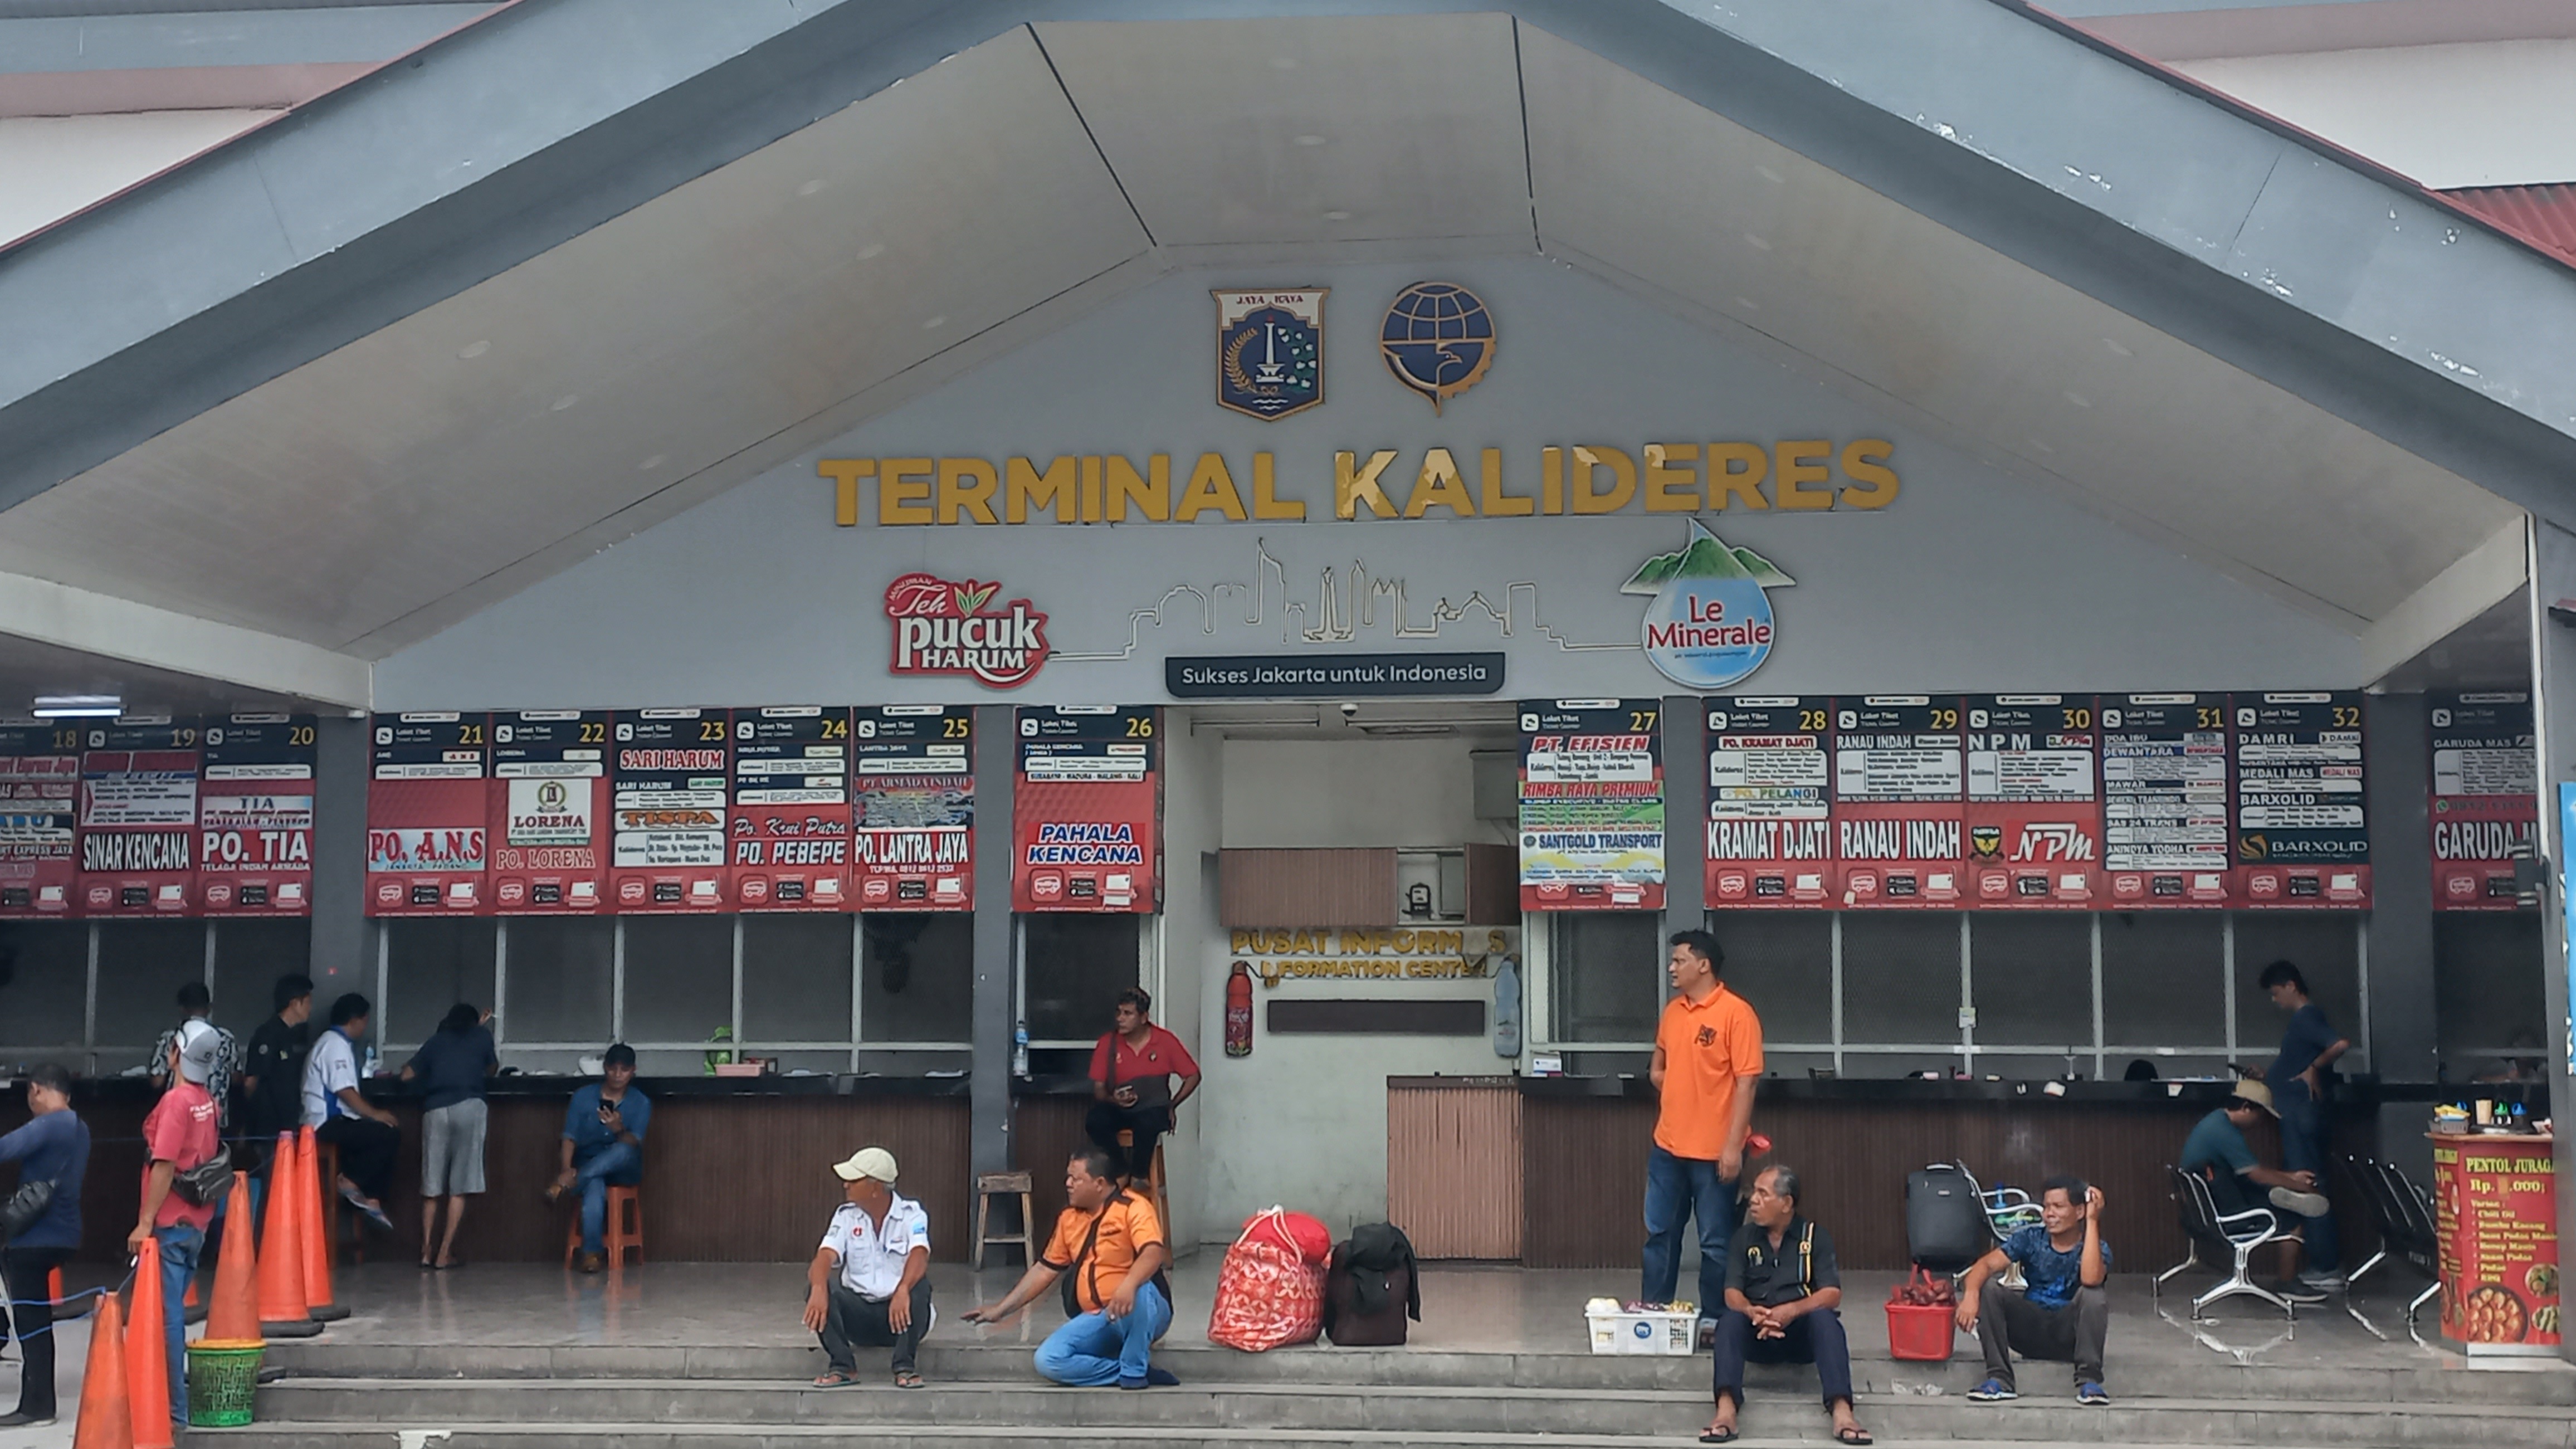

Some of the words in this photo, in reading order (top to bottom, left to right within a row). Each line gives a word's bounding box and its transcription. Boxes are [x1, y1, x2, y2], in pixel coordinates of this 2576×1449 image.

[817, 452, 1306, 526] TERMINAL
[1334, 439, 1900, 520] KALIDERES
[889, 584, 948, 616] Teh
[1689, 596, 1723, 623] Le
[897, 606, 1041, 669] pucuk
[1647, 618, 1771, 649] Minerale
[921, 648, 1026, 669] HARUM
[1182, 668, 1248, 684] Sukses
[1252, 666, 1326, 684] Jakarta
[1329, 666, 1385, 682] untuk
[1389, 663, 1486, 681] Indonesia
[1629, 711, 1657, 732] 27
[1799, 710, 1827, 730] 28
[1929, 709, 1958, 730] 29
[2062, 709, 2091, 729] 30
[2196, 708, 2224, 729] 31
[2332, 707, 2360, 727] 32
[171, 728, 196, 747] 19
[289, 726, 315, 745] 20
[459, 726, 484, 744] 21
[579, 724, 606, 742] 22
[699, 721, 725, 741] 23
[821, 720, 848, 739] 24
[943, 718, 969, 738] 25
[1126, 718, 1153, 737] 26
[54, 730, 77, 748] 18
[1531, 736, 1563, 753] PT.
[1568, 735, 1651, 753] EFISIEN
[1723, 739, 1739, 748] PO.
[1741, 739, 1783, 748] KRAMAT
[1785, 738, 1814, 748] DJATI
[1836, 735, 1874, 749] RANAU
[1877, 734, 1911, 749] INDAH
[2239, 734, 2294, 744] DAMRI
[2434, 739, 2483, 748] GARUDA
[620, 749, 661, 770] SARI
[662, 749, 725, 770] HARUM
[2103, 747, 2174, 757] DEWANTARA
[2240, 768, 2285, 779] MEDALI
[2287, 768, 2314, 778] MAS
[1523, 783, 1562, 797] RIMBA
[1602, 782, 1659, 797] PREMIUM
[1760, 788, 1817, 798] PELANGI
[240, 798, 275, 809] TIA
[2240, 794, 2315, 806] BARXOLID
[514, 816, 585, 828] LORENA
[734, 818, 756, 837] Po.
[1038, 823, 1133, 843] PAHALA
[1598, 834, 1662, 848] TRANSPORT
[1707, 821, 1778, 860] KRAMAT
[1783, 821, 1831, 860] DJATI
[1840, 821, 1901, 860] RANAU
[1906, 820, 1961, 860] INDAH
[2434, 822, 2515, 860] GARUDA
[84, 834, 123, 871] SINAR
[125, 832, 189, 870] KENCANA
[202, 832, 250, 862] PO.
[260, 832, 309, 861] TIA
[735, 842, 765, 865] PO.
[772, 841, 847, 865] PEBEPE
[855, 834, 876, 864] PO.
[880, 833, 933, 863] LANTRA
[935, 833, 969, 863] JAYA
[1027, 845, 1143, 865] KENCANA
[2272, 841, 2368, 852] BARXOLID
[496, 850, 524, 870] PO.
[528, 848, 596, 869] LORENA
[1231, 930, 1331, 954] PUSAT
[2466, 1157, 2511, 1173] PENTOL
[2514, 1158, 2554, 1173] JURAG
[2470, 1178, 2495, 1194] Rp.
